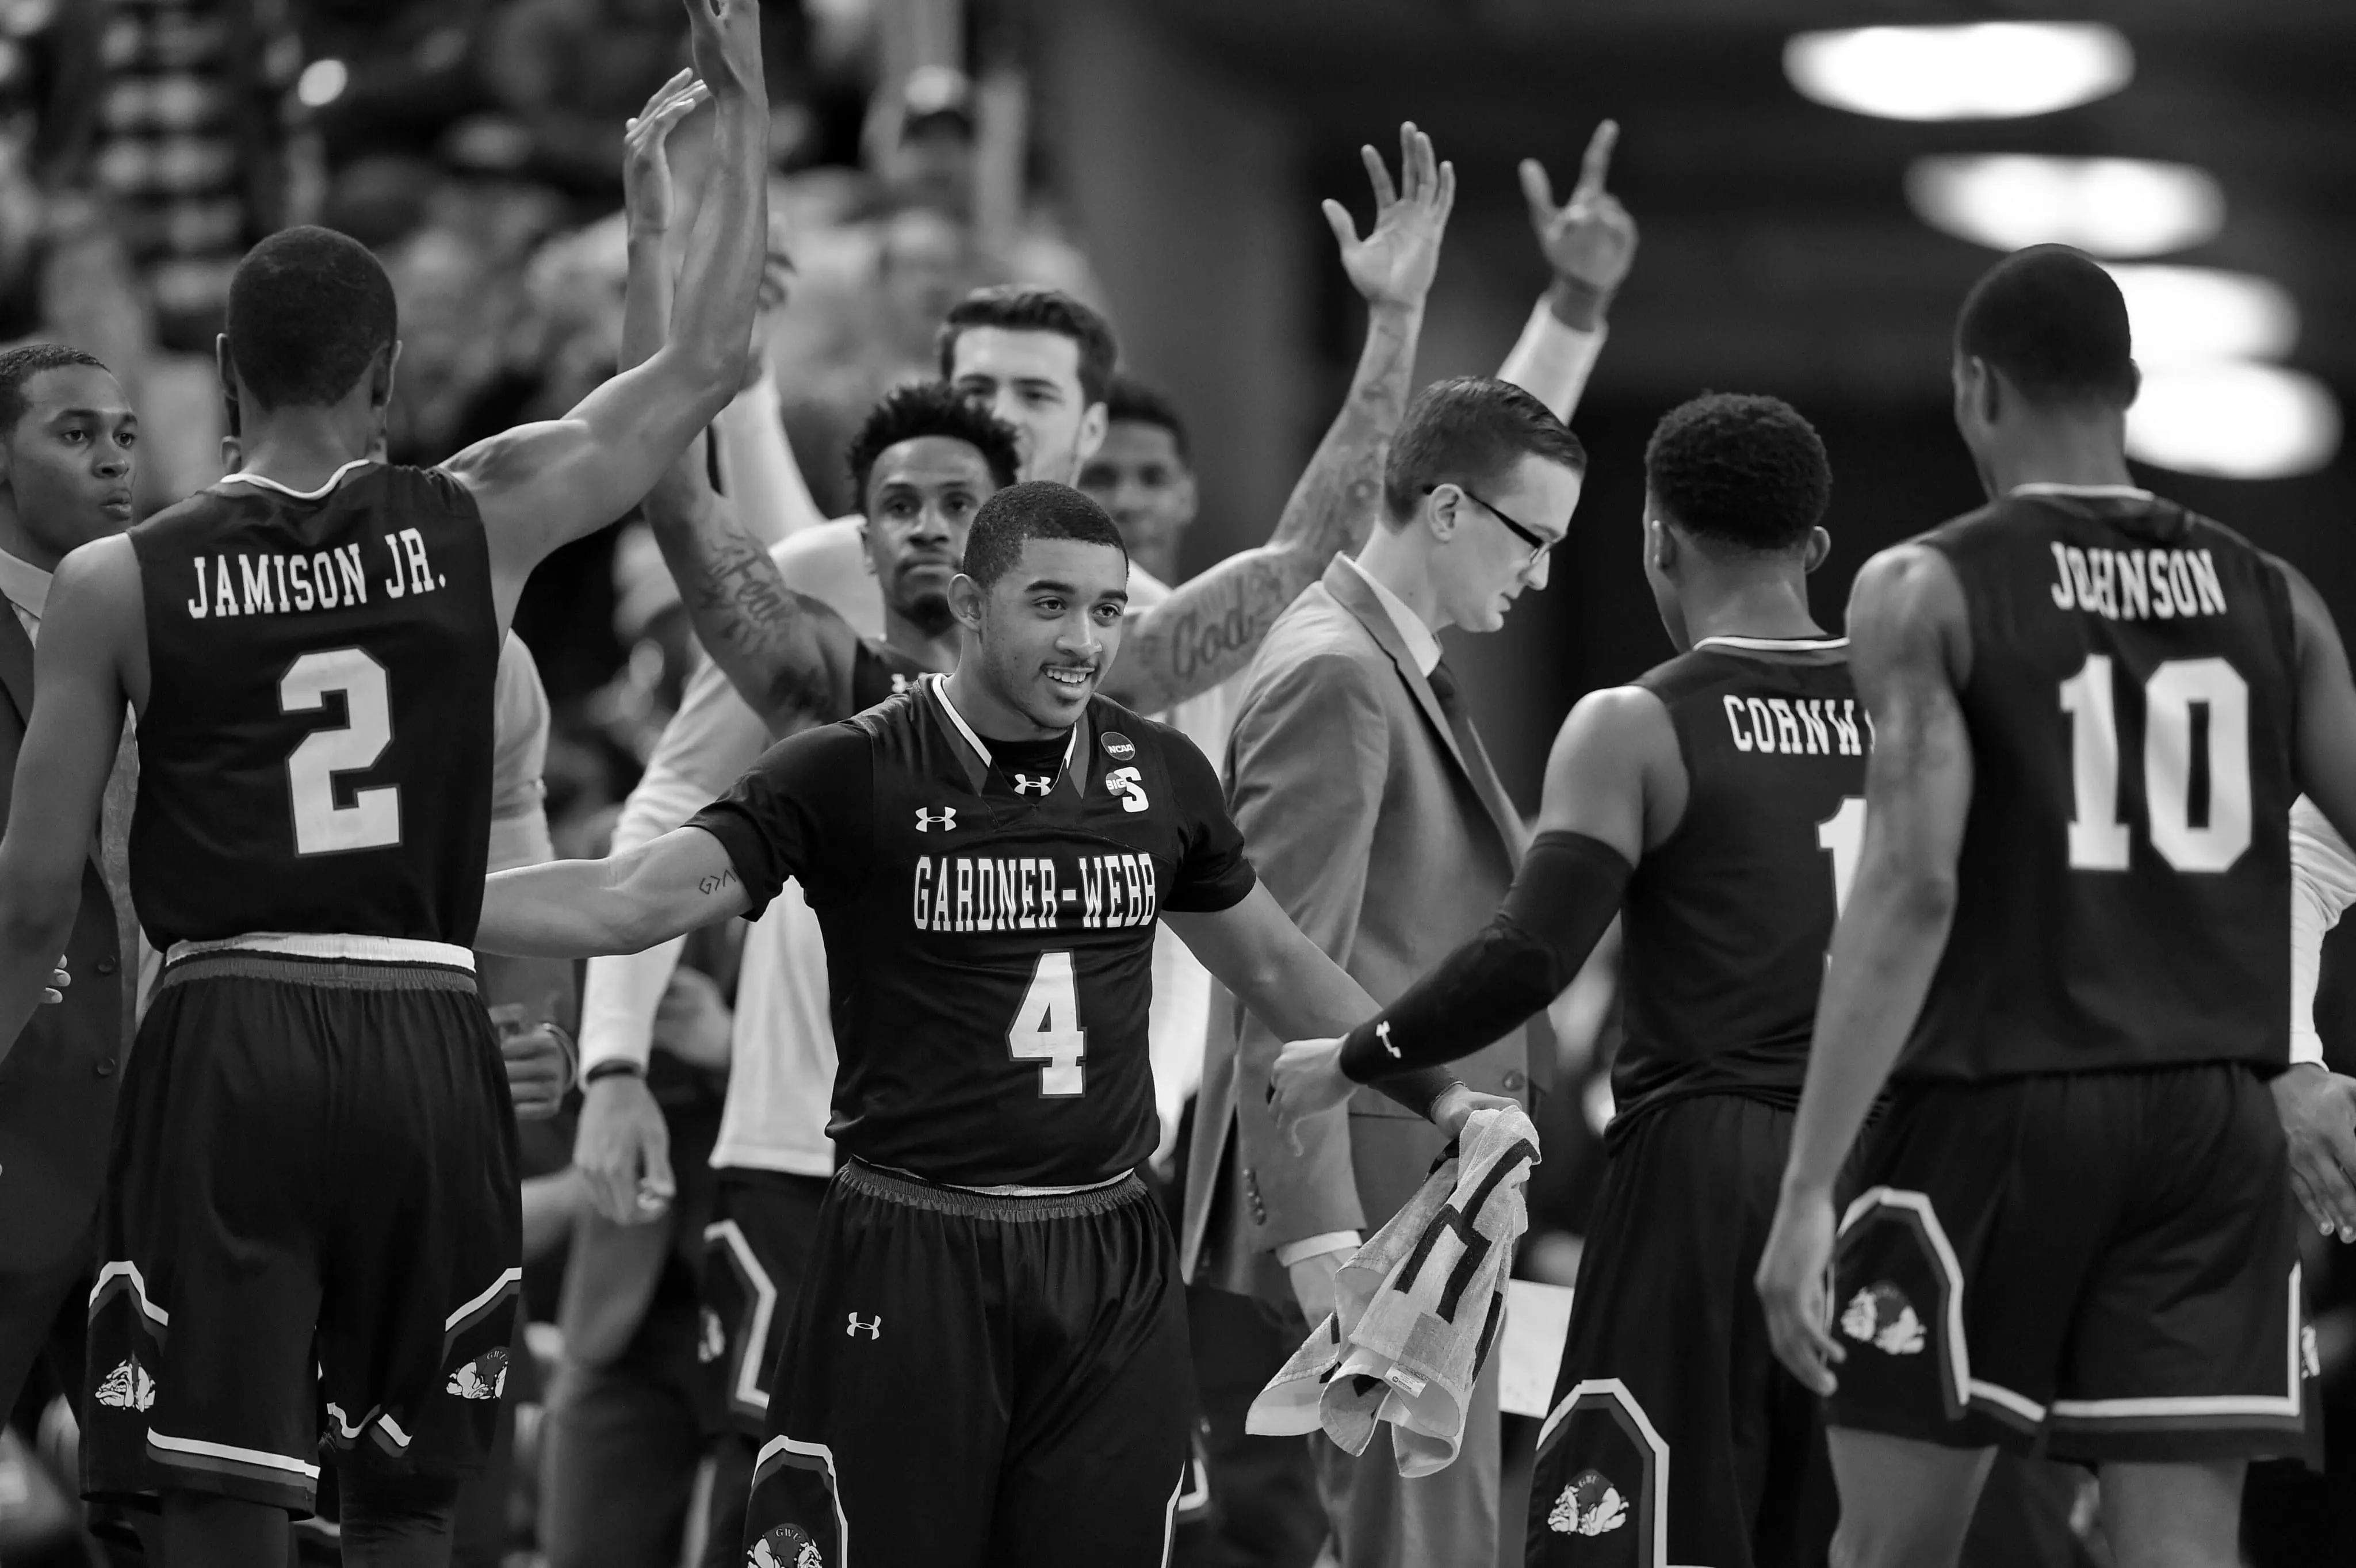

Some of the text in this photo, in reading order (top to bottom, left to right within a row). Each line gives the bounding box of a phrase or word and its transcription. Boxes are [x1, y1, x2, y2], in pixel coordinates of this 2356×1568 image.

[188, 527, 447, 619] JAMISON JR.
[2049, 540, 2227, 621] JOHNSON
[278, 645, 401, 857] 2
[1107, 743, 1134, 754] NCAA
[1723, 694, 1876, 756] CORNW
[2059, 652, 2253, 873] 10
[1106, 778, 1127, 790] BIG
[913, 853, 1156, 932] GARDNER-WEBB
[1007, 949, 1087, 1097] 4
